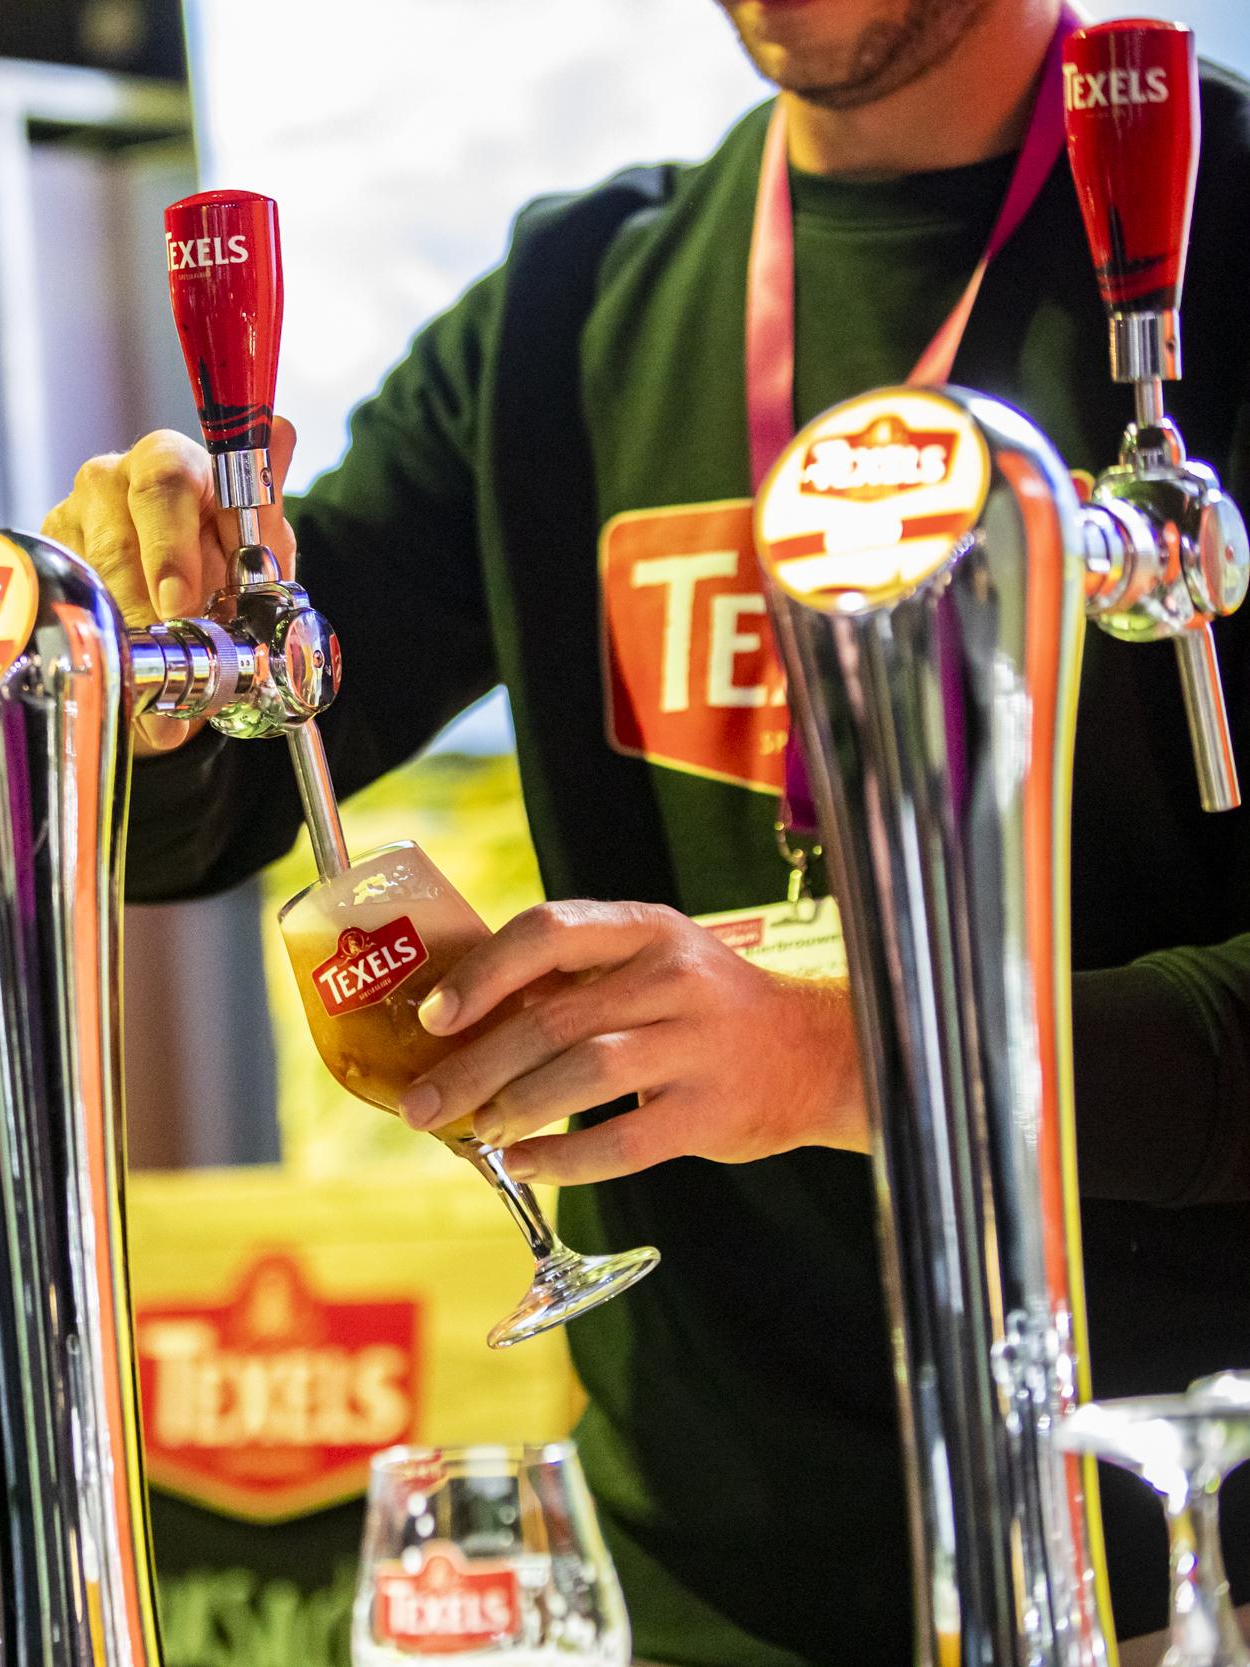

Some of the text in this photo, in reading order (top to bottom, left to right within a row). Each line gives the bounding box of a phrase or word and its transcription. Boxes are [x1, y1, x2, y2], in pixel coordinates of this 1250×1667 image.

[1062, 63, 1169, 112] TEXELS
[318, 936, 418, 1005] TEXELS
[143, 1318, 409, 1449] TEXELS
[385, 1580, 510, 1635] TEXELS
